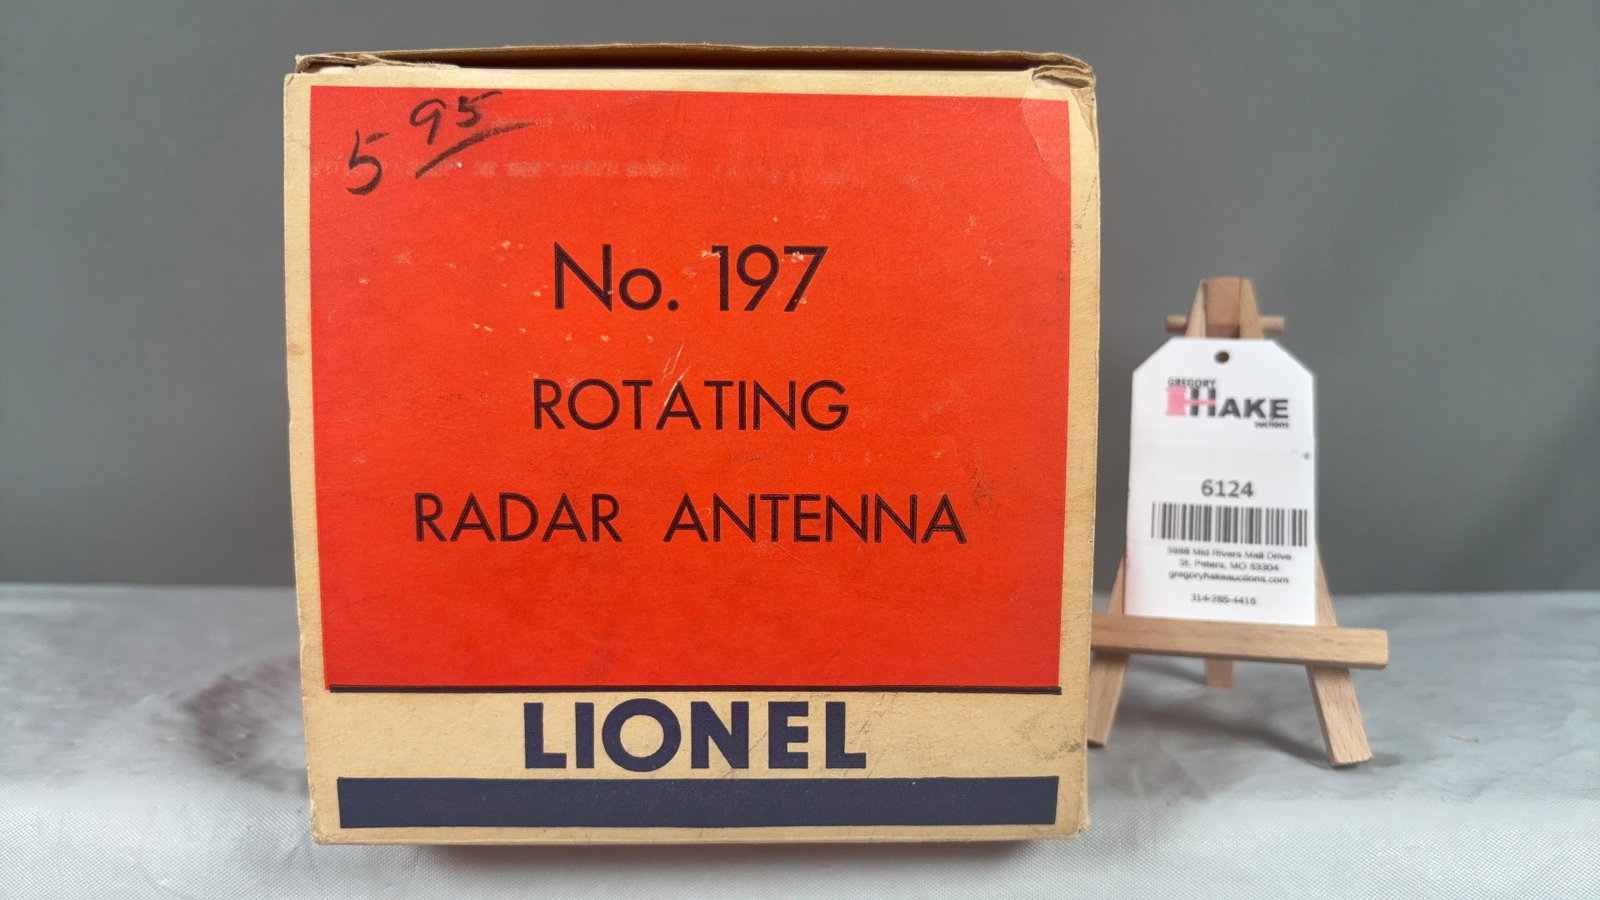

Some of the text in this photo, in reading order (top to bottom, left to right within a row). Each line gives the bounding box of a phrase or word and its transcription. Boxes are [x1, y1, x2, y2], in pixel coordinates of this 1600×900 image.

[554, 241, 828, 312] No. 197
[1168, 378, 1216, 388] GREGORY
[533, 378, 850, 431] ROTATING
[1201, 479, 1254, 498] 6124
[414, 492, 968, 545] RADAR ANTENNA
[1192, 547, 1210, 557] Mid
[1212, 548, 1241, 559] Rivers
[1244, 550, 1264, 560] Mall
[1267, 551, 1291, 561] Drive
[1230, 559, 1246, 569] MO
[523, 698, 867, 772] LIONEL
